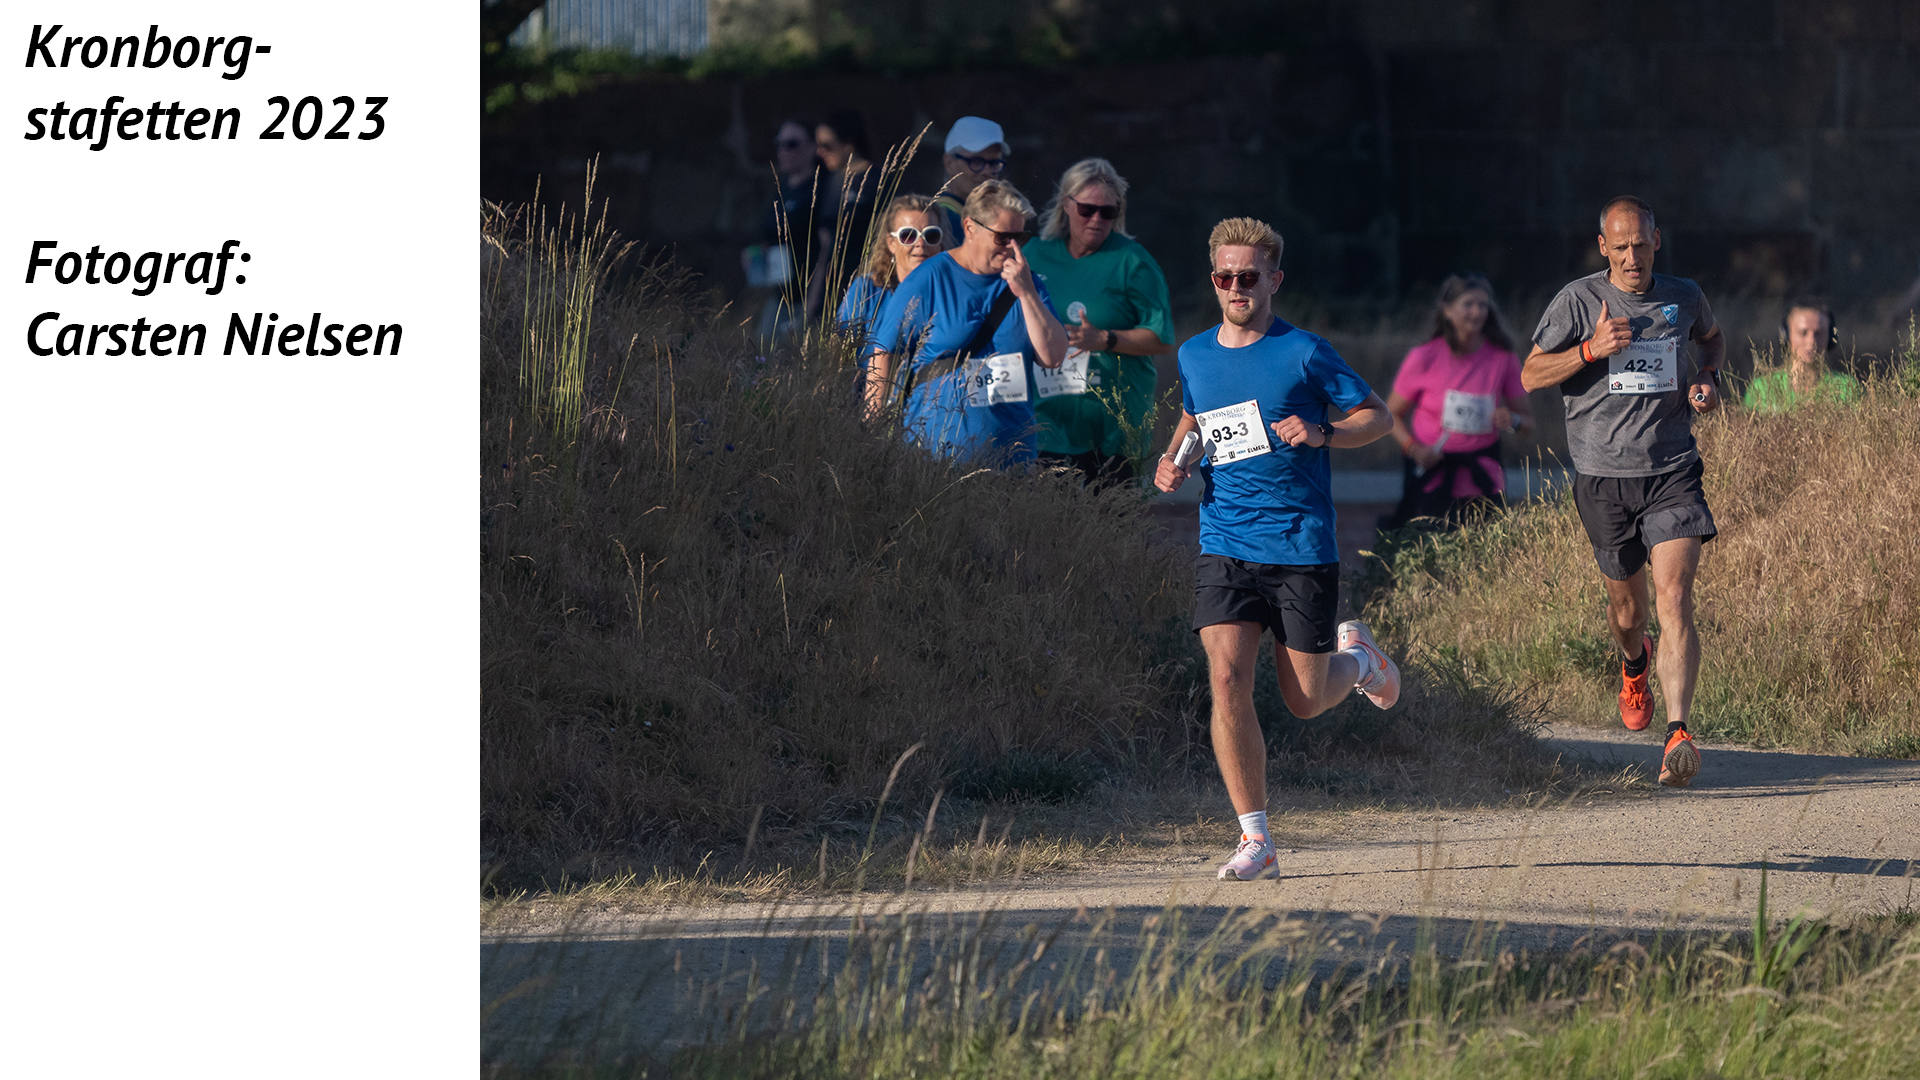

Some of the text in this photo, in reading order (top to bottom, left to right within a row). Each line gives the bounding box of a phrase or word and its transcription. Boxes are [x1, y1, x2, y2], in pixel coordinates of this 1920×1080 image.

[1624, 358, 1663, 372] 42-2
[975, 371, 1011, 387] 98-2
[1207, 406, 1246, 420] KRONBORG
[1212, 422, 1249, 443] 93-3
